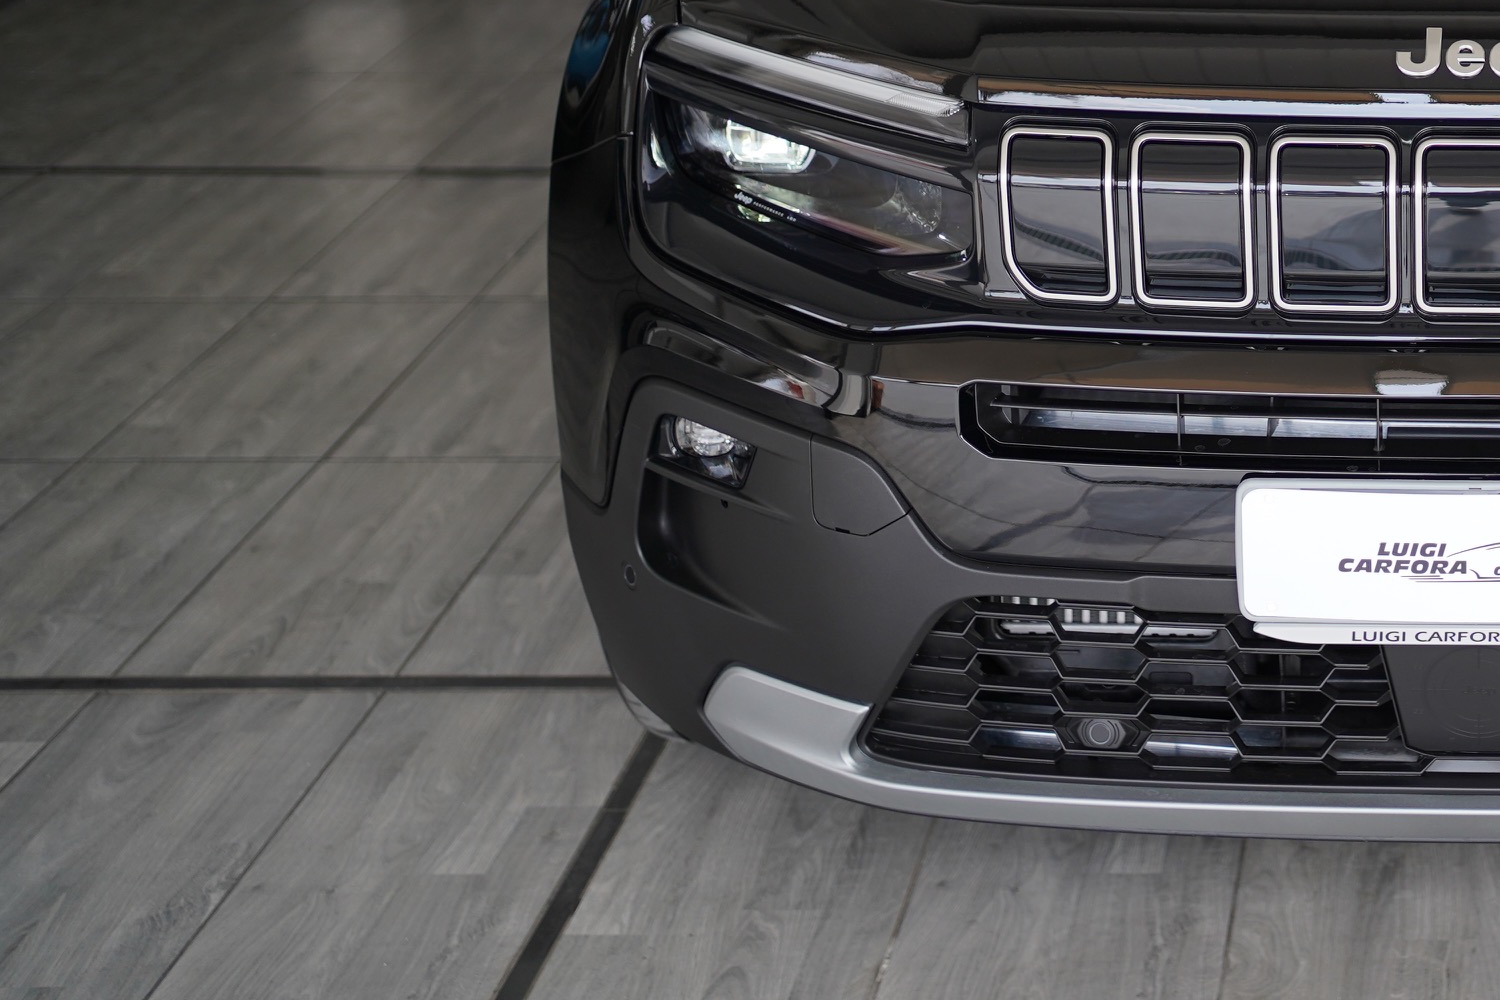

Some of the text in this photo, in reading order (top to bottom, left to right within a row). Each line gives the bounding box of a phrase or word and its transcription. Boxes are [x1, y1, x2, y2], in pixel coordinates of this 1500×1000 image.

[1376, 542, 1447, 557] LUIGI
[1337, 558, 1468, 575] CARFORA
[1351, 630, 1407, 642] LUIGI
